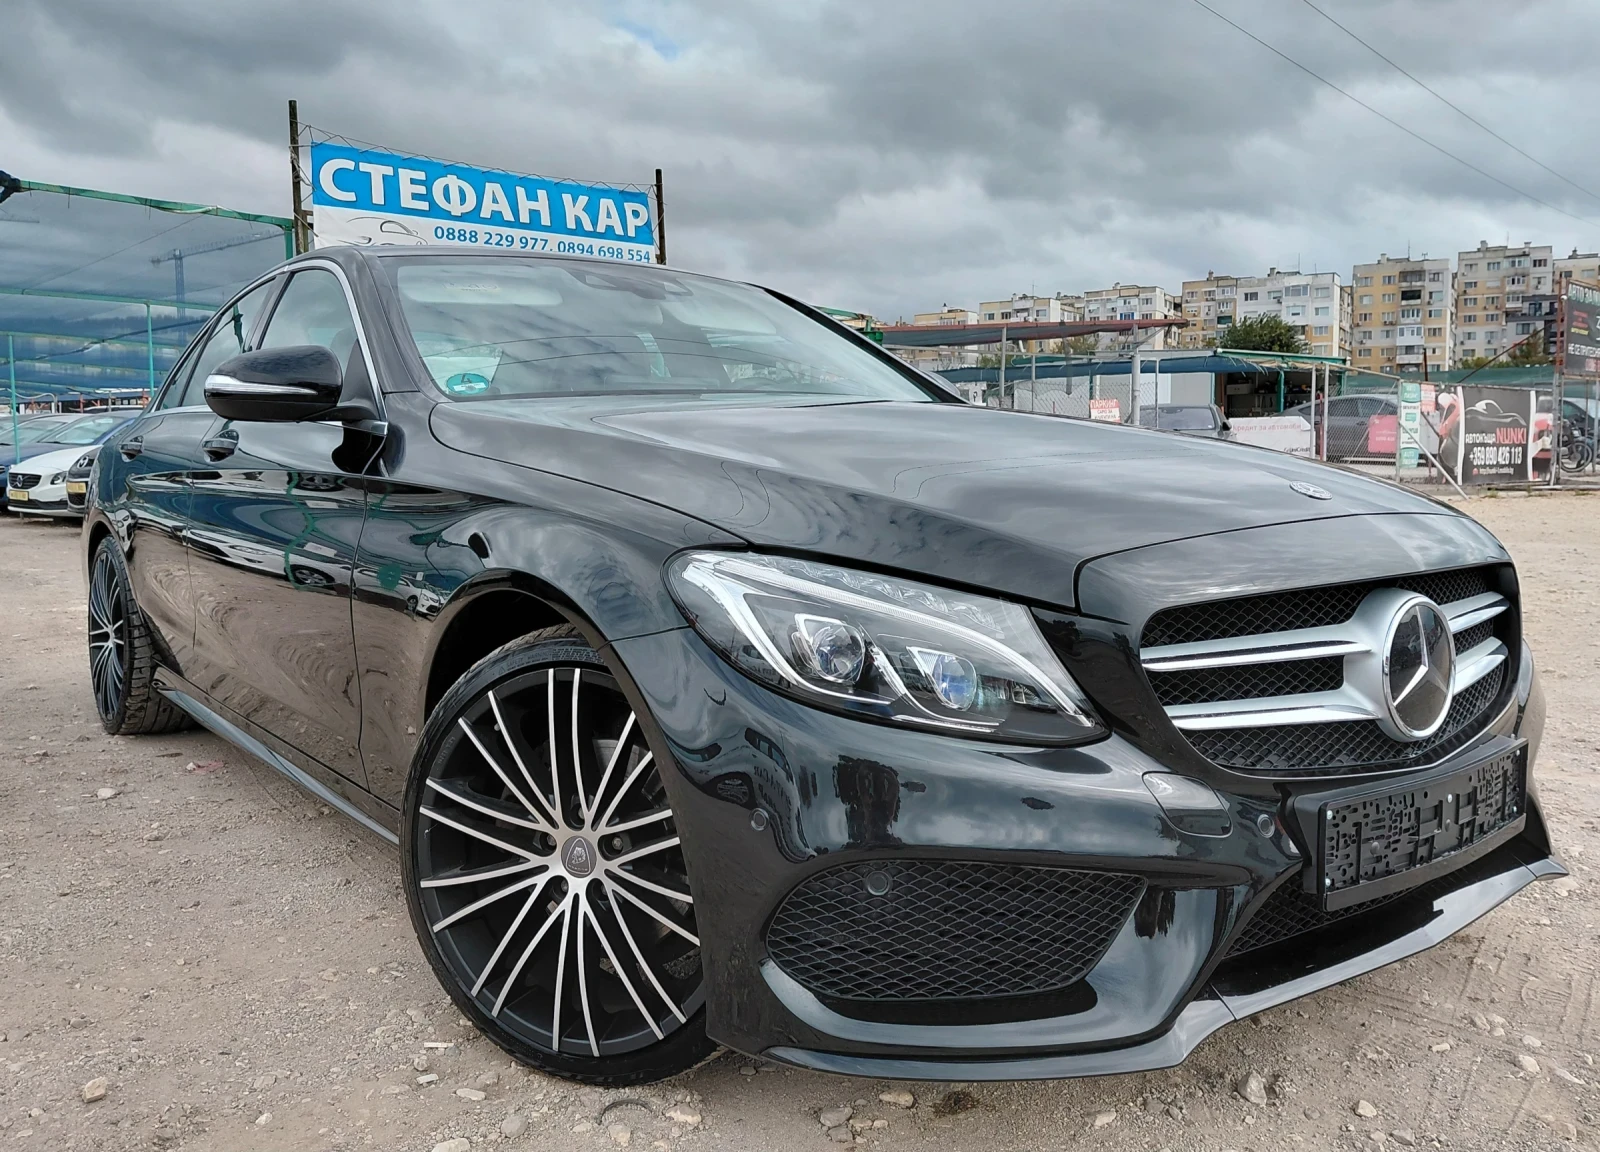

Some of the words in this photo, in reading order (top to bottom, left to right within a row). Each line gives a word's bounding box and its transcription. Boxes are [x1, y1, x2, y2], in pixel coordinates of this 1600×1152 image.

[318, 157, 551, 228] СТЕФАН
[562, 193, 649, 238] КАР
[433, 225, 479, 244] 0888
[483, 231, 515, 249] 229
[557, 240, 594, 256] 0894
[597, 246, 624, 260] 698
[627, 248, 651, 264] 554
[1090, 399, 1116, 409] ПАРКИНГ
[1496, 427, 1527, 444] NUNKI
[1469, 446, 1485, 466] +359
[1485, 446, 1497, 465] 890
[1498, 446, 1510, 465] 426
[1510, 446, 1523, 464] 113
